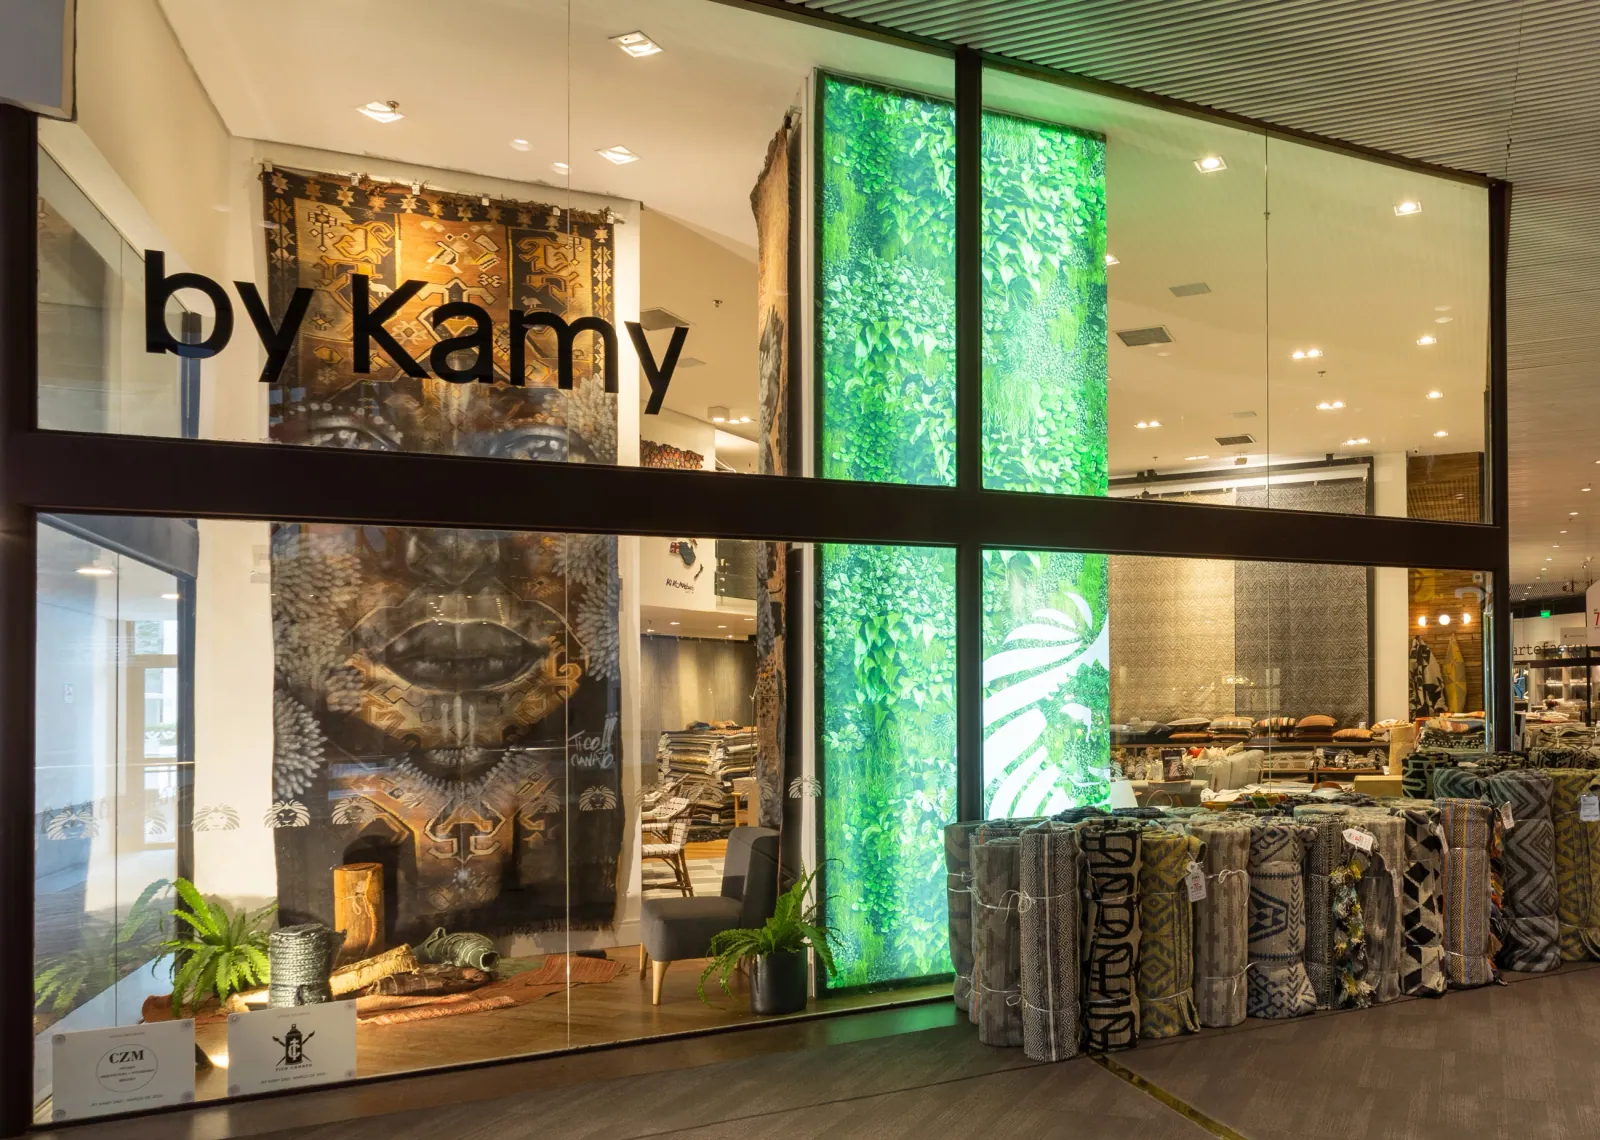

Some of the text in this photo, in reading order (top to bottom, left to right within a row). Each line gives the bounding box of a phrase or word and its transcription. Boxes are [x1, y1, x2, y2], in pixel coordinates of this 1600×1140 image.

[144, 249, 690, 415] by Kamy
[109, 1049, 145, 1065] CZM
